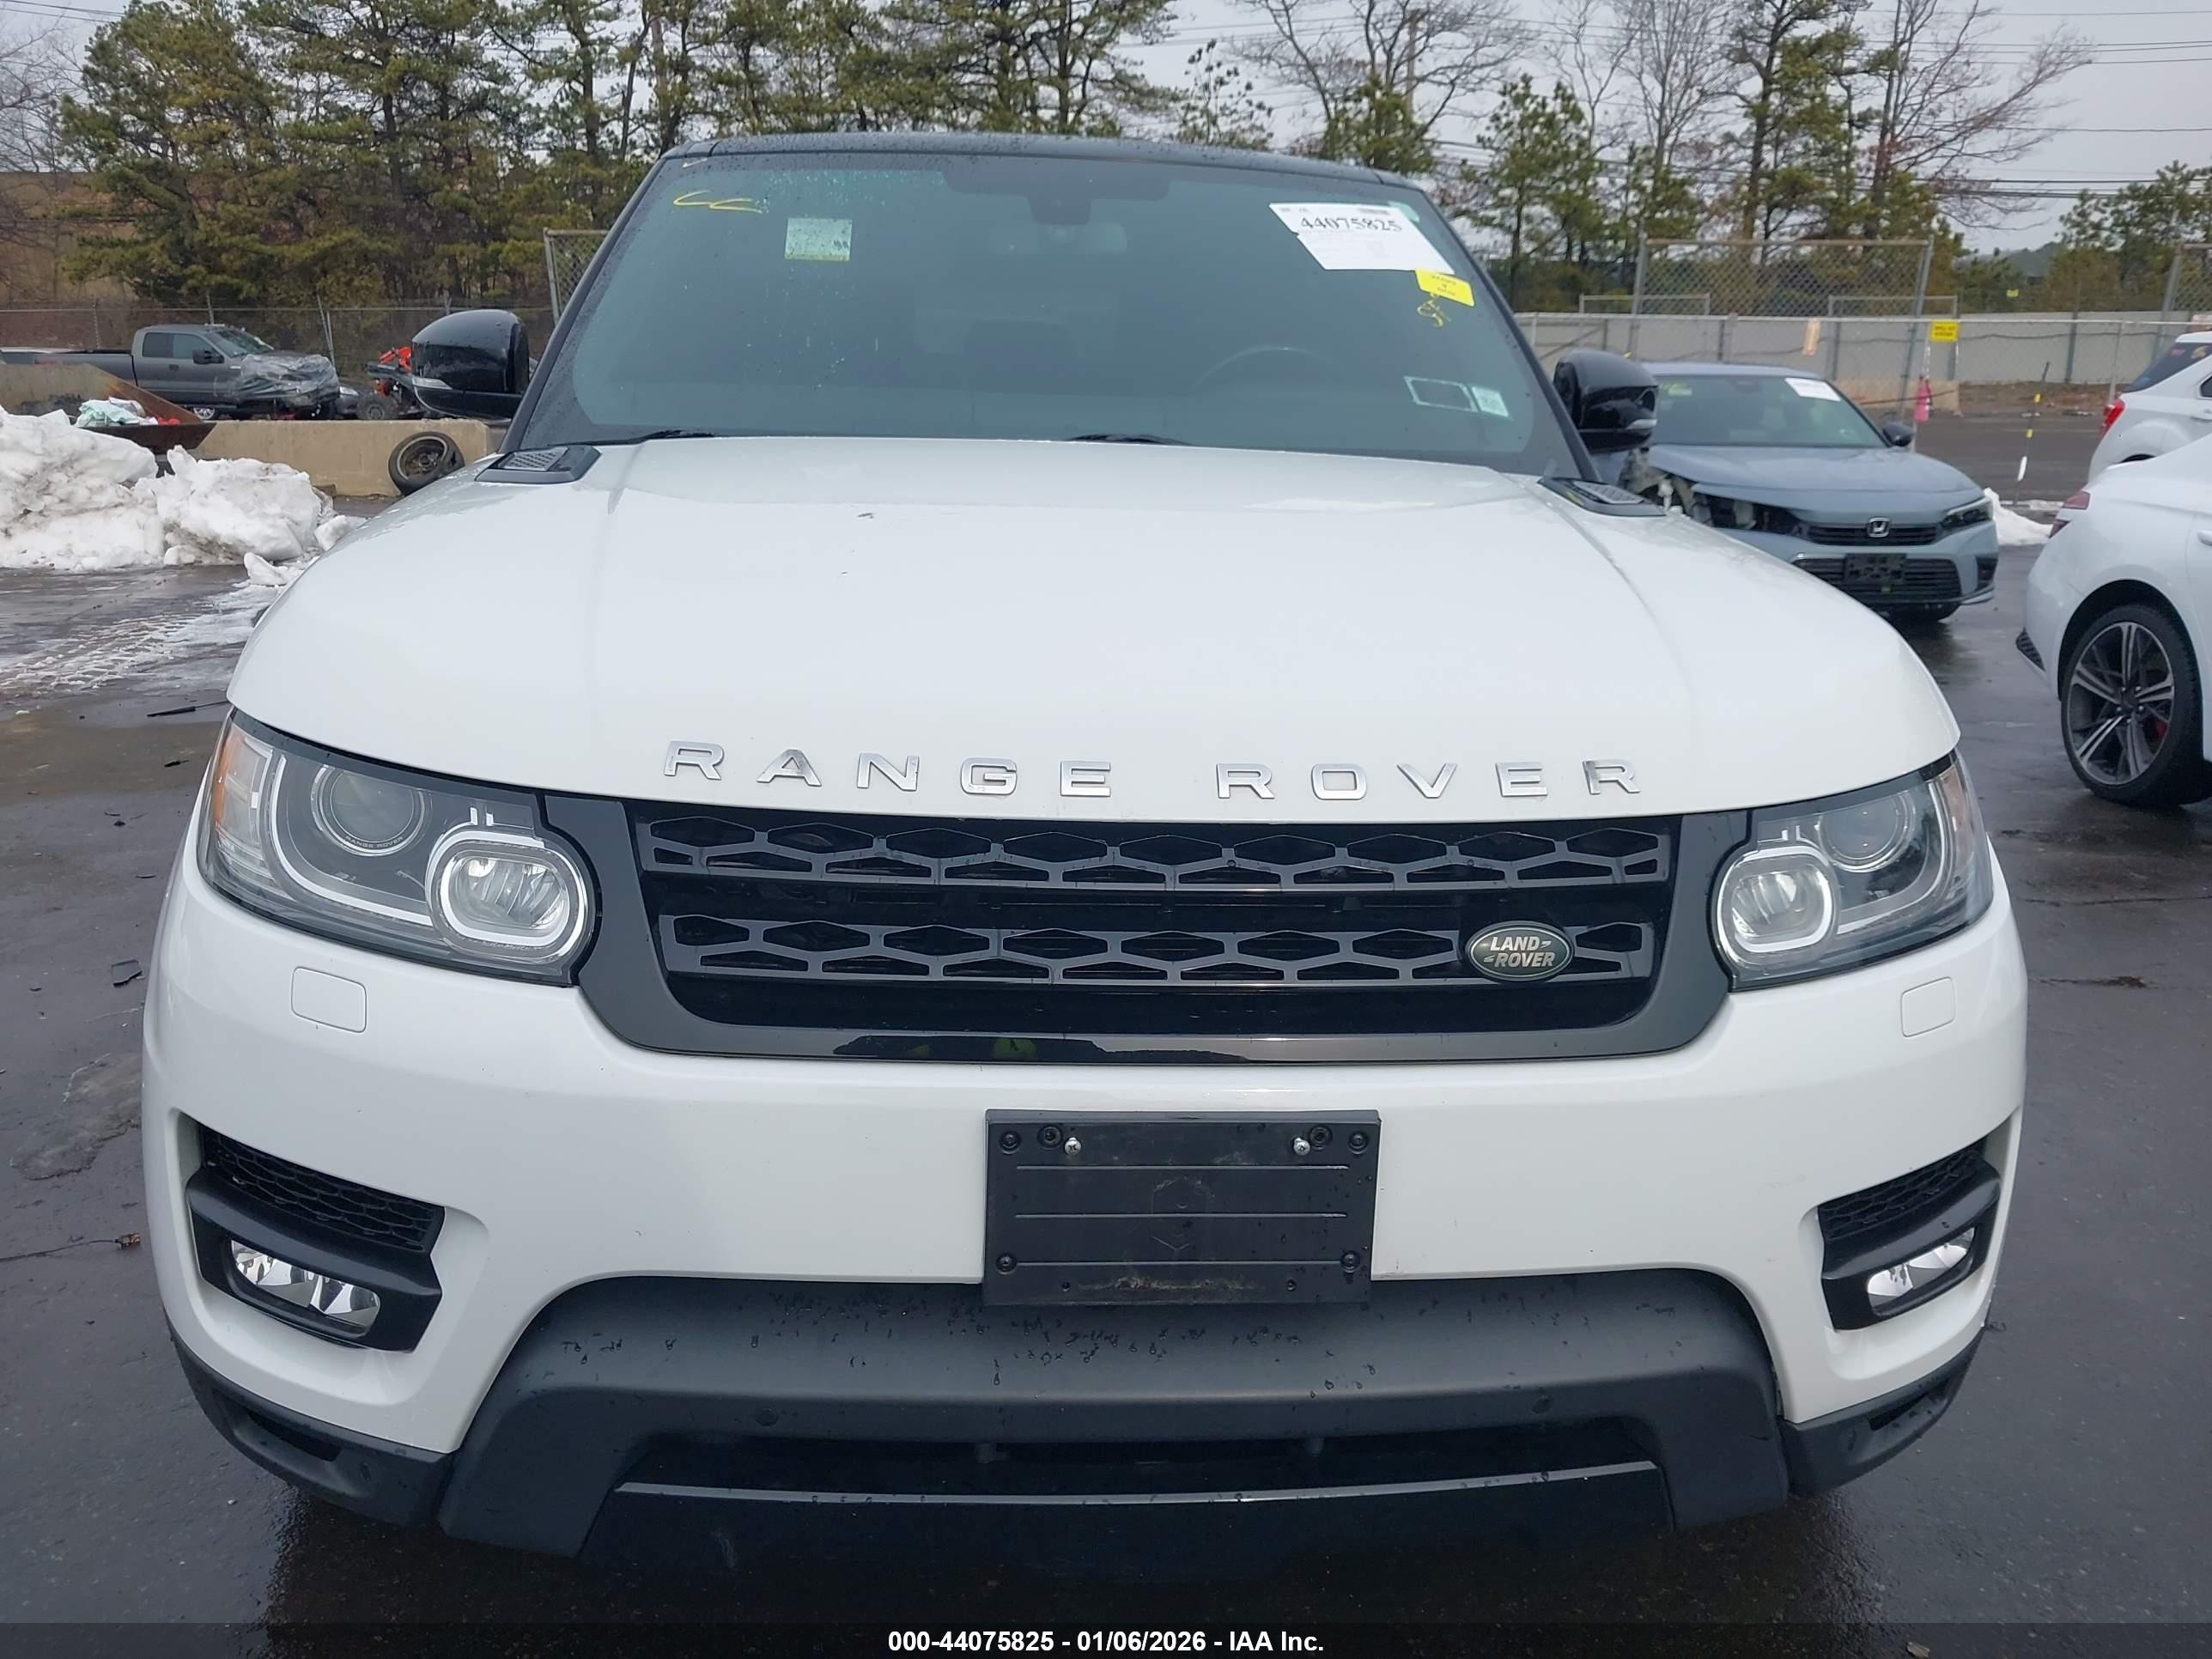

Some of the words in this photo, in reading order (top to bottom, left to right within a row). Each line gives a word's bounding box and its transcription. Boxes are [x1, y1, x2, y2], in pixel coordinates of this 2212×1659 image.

[1301, 216, 1402, 232] 44075825
[663, 740, 1112, 798] RANGE
[1216, 758, 1641, 800] ROVER
[1490, 936, 1540, 951] LAND
[1494, 951, 1556, 968] ROVER
